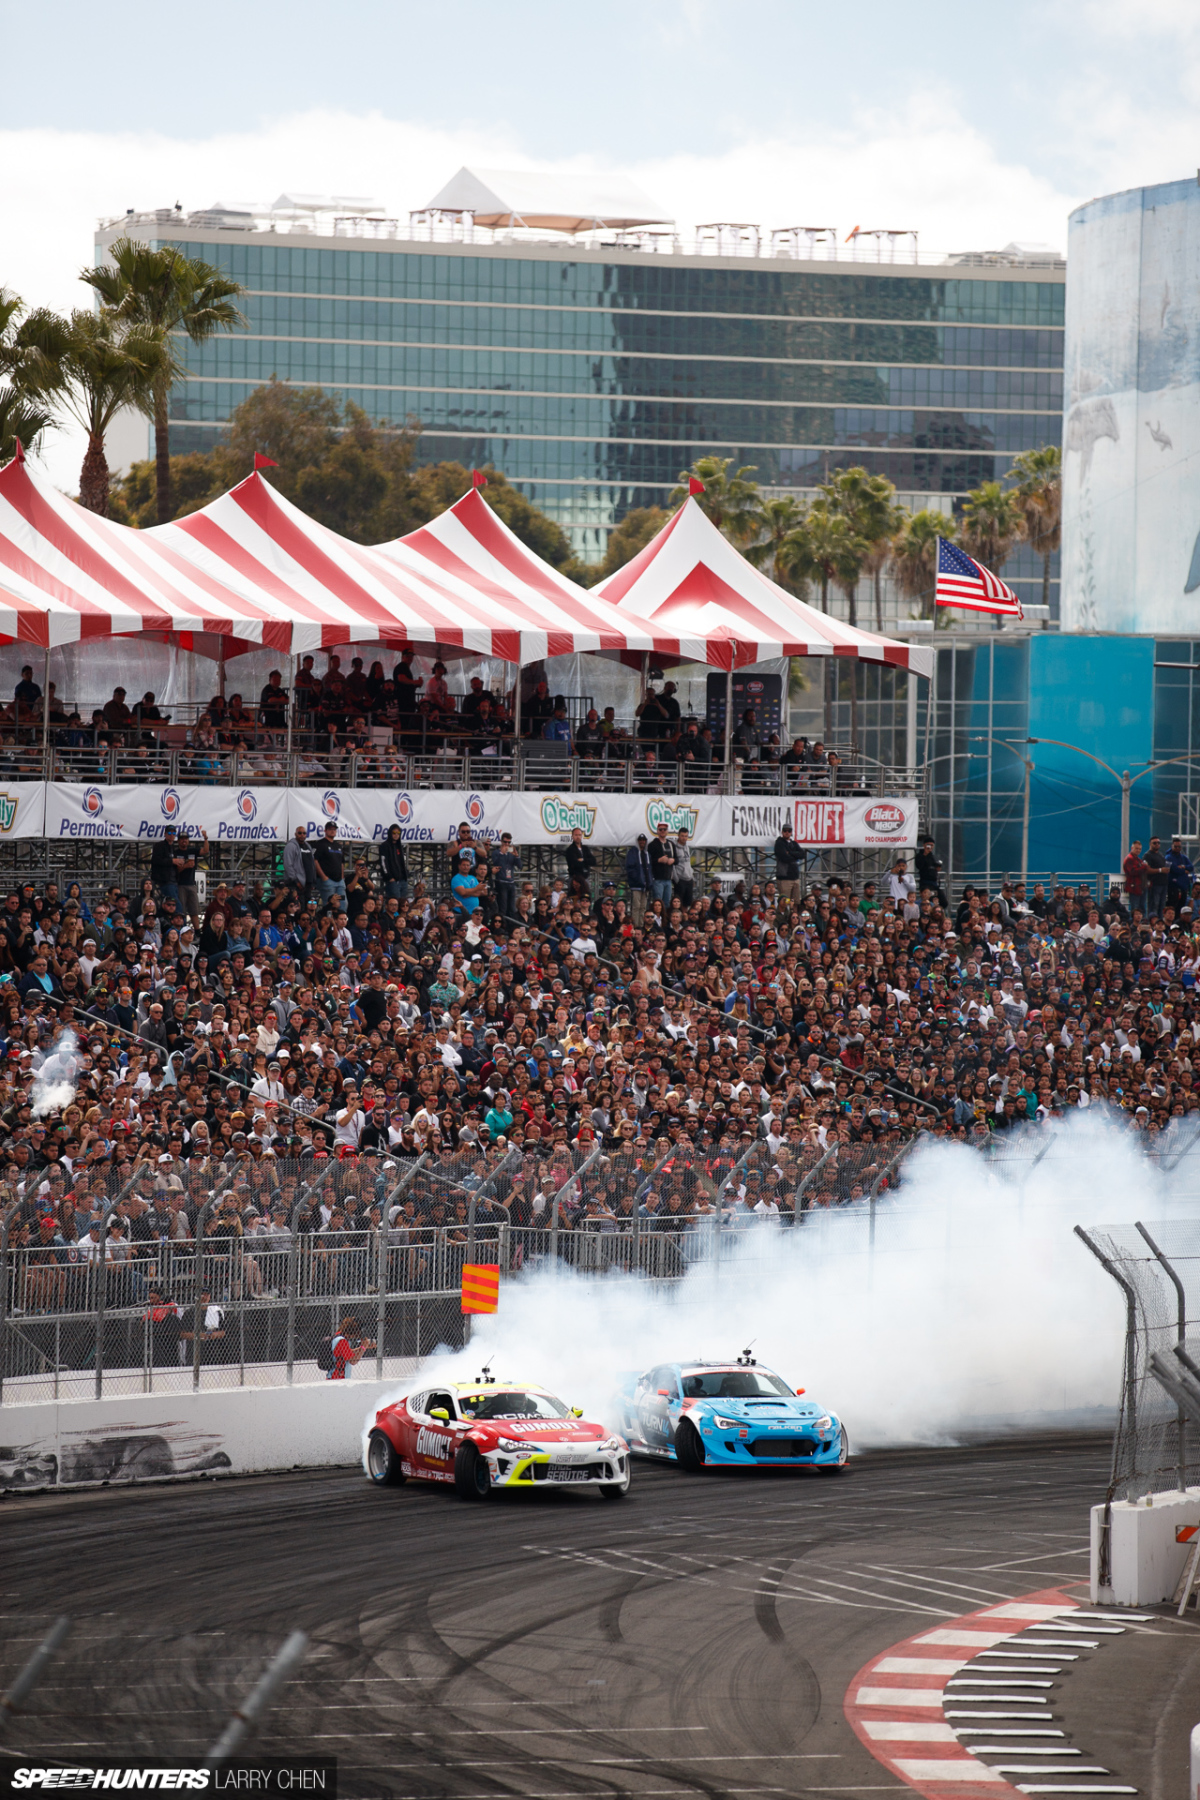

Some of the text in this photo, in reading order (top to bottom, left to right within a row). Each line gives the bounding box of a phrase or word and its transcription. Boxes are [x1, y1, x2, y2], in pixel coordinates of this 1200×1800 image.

[543, 801, 593, 834] O'Reilly
[648, 803, 696, 836] O'Reilly
[796, 802, 843, 842] DRIFT
[870, 807, 901, 820] Black
[59, 818, 124, 837] Permatex
[217, 821, 278, 839] Permatex
[306, 821, 362, 839] Peatex
[372, 823, 435, 841] Peatex
[447, 824, 502, 842] Pmatex
[874, 821, 901, 831] Magic
[864, 835, 875, 843] PRO
[509, 1421, 580, 1434] GUMOUT
[416, 1426, 453, 1461] GUMOUT
[546, 1470, 589, 1481] SERVICE
